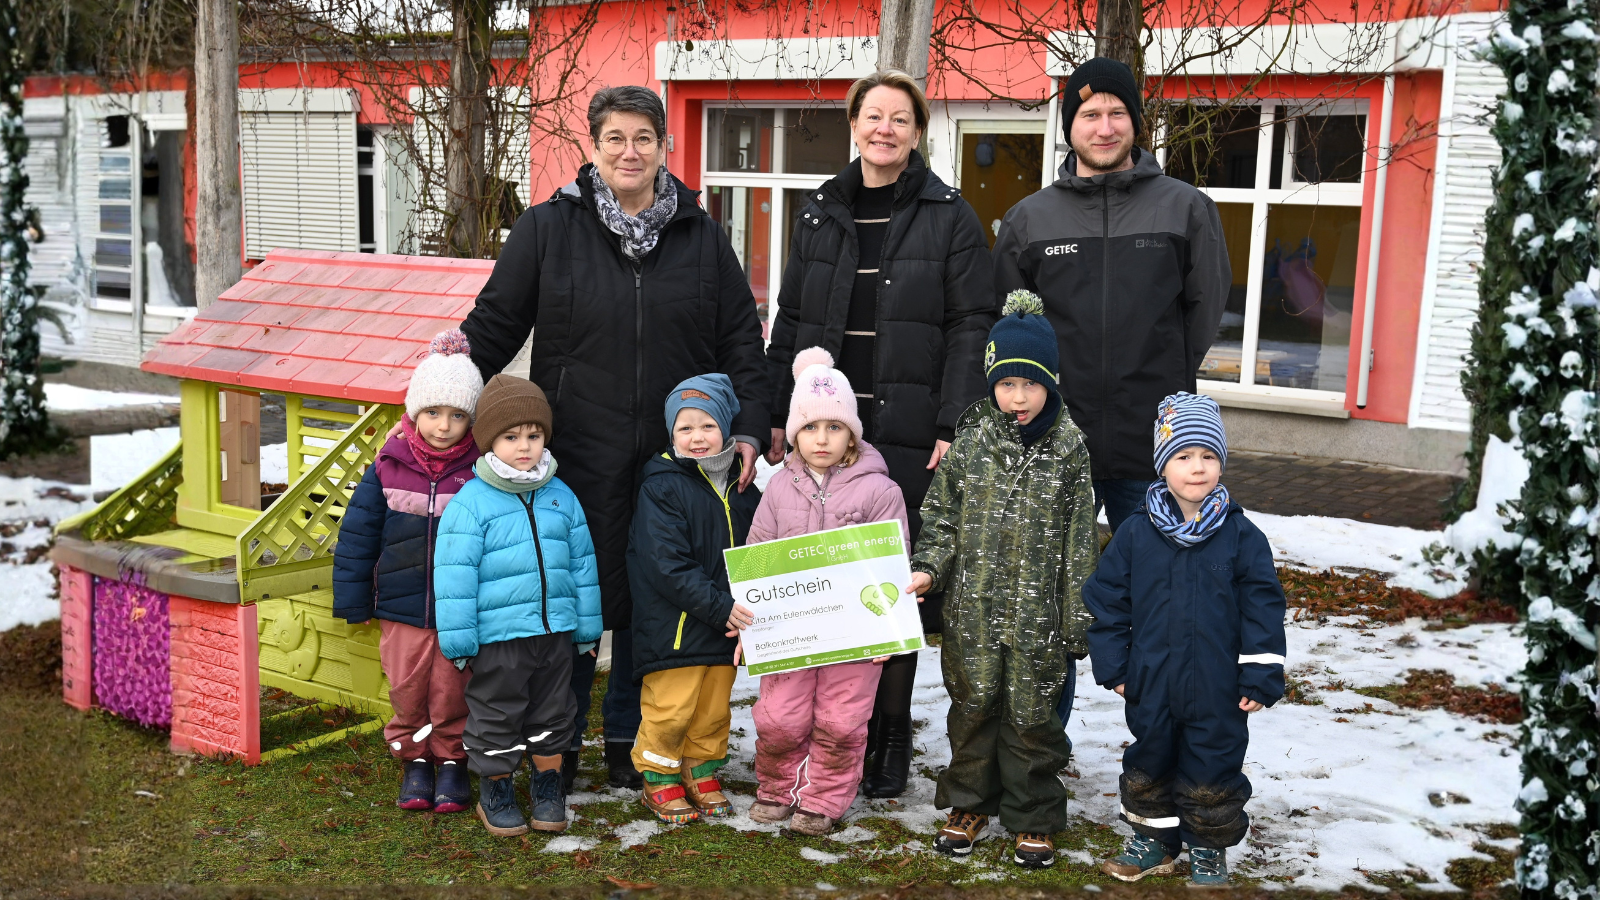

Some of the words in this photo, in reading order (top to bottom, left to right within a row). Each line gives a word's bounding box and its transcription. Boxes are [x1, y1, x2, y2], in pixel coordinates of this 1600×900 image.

[1045, 244, 1078, 256] GETEC
[789, 544, 825, 560] GETEC
[828, 541, 860, 556] green
[864, 535, 901, 547] energy
[831, 554, 849, 562] GmbH
[746, 577, 832, 603] Gutschein
[768, 613, 782, 622] Am
[783, 604, 844, 620] Eulenwäldchen
[755, 634, 819, 651] Balkonkraftwerk
